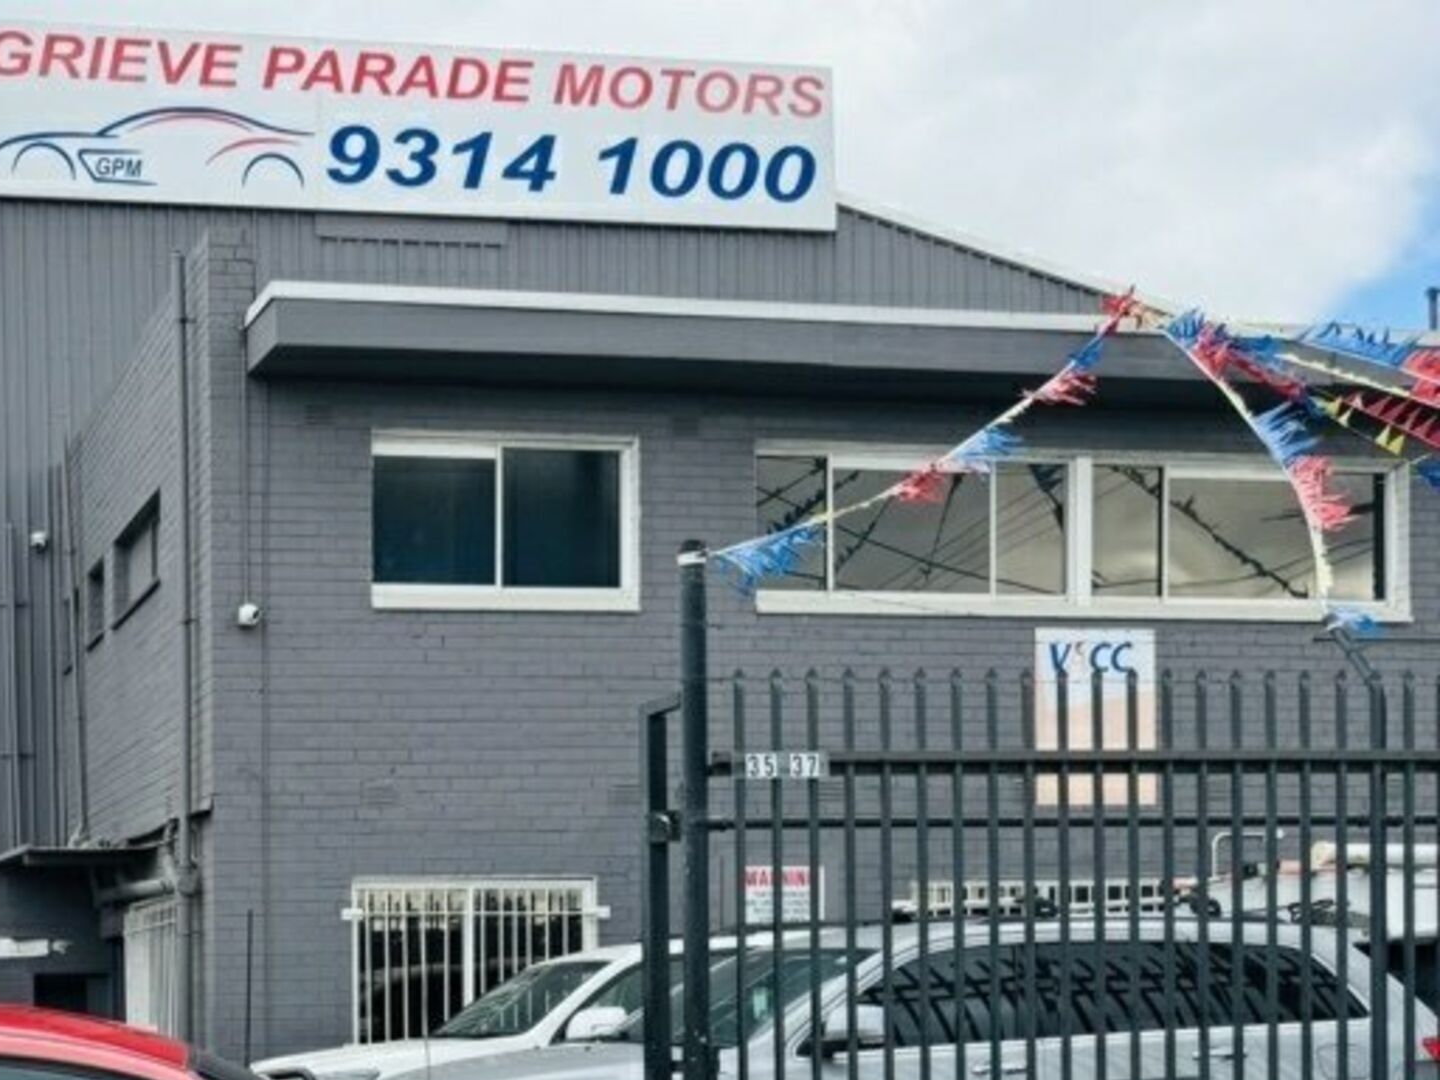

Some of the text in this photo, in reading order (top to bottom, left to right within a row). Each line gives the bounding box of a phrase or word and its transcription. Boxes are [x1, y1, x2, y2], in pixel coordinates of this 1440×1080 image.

[262, 46, 534, 102] PARADE
[553, 63, 825, 118] MOTORS
[95, 156, 142, 178] GPM
[326, 124, 816, 203] 9314 1000
[747, 755, 817, 777] 35 37
